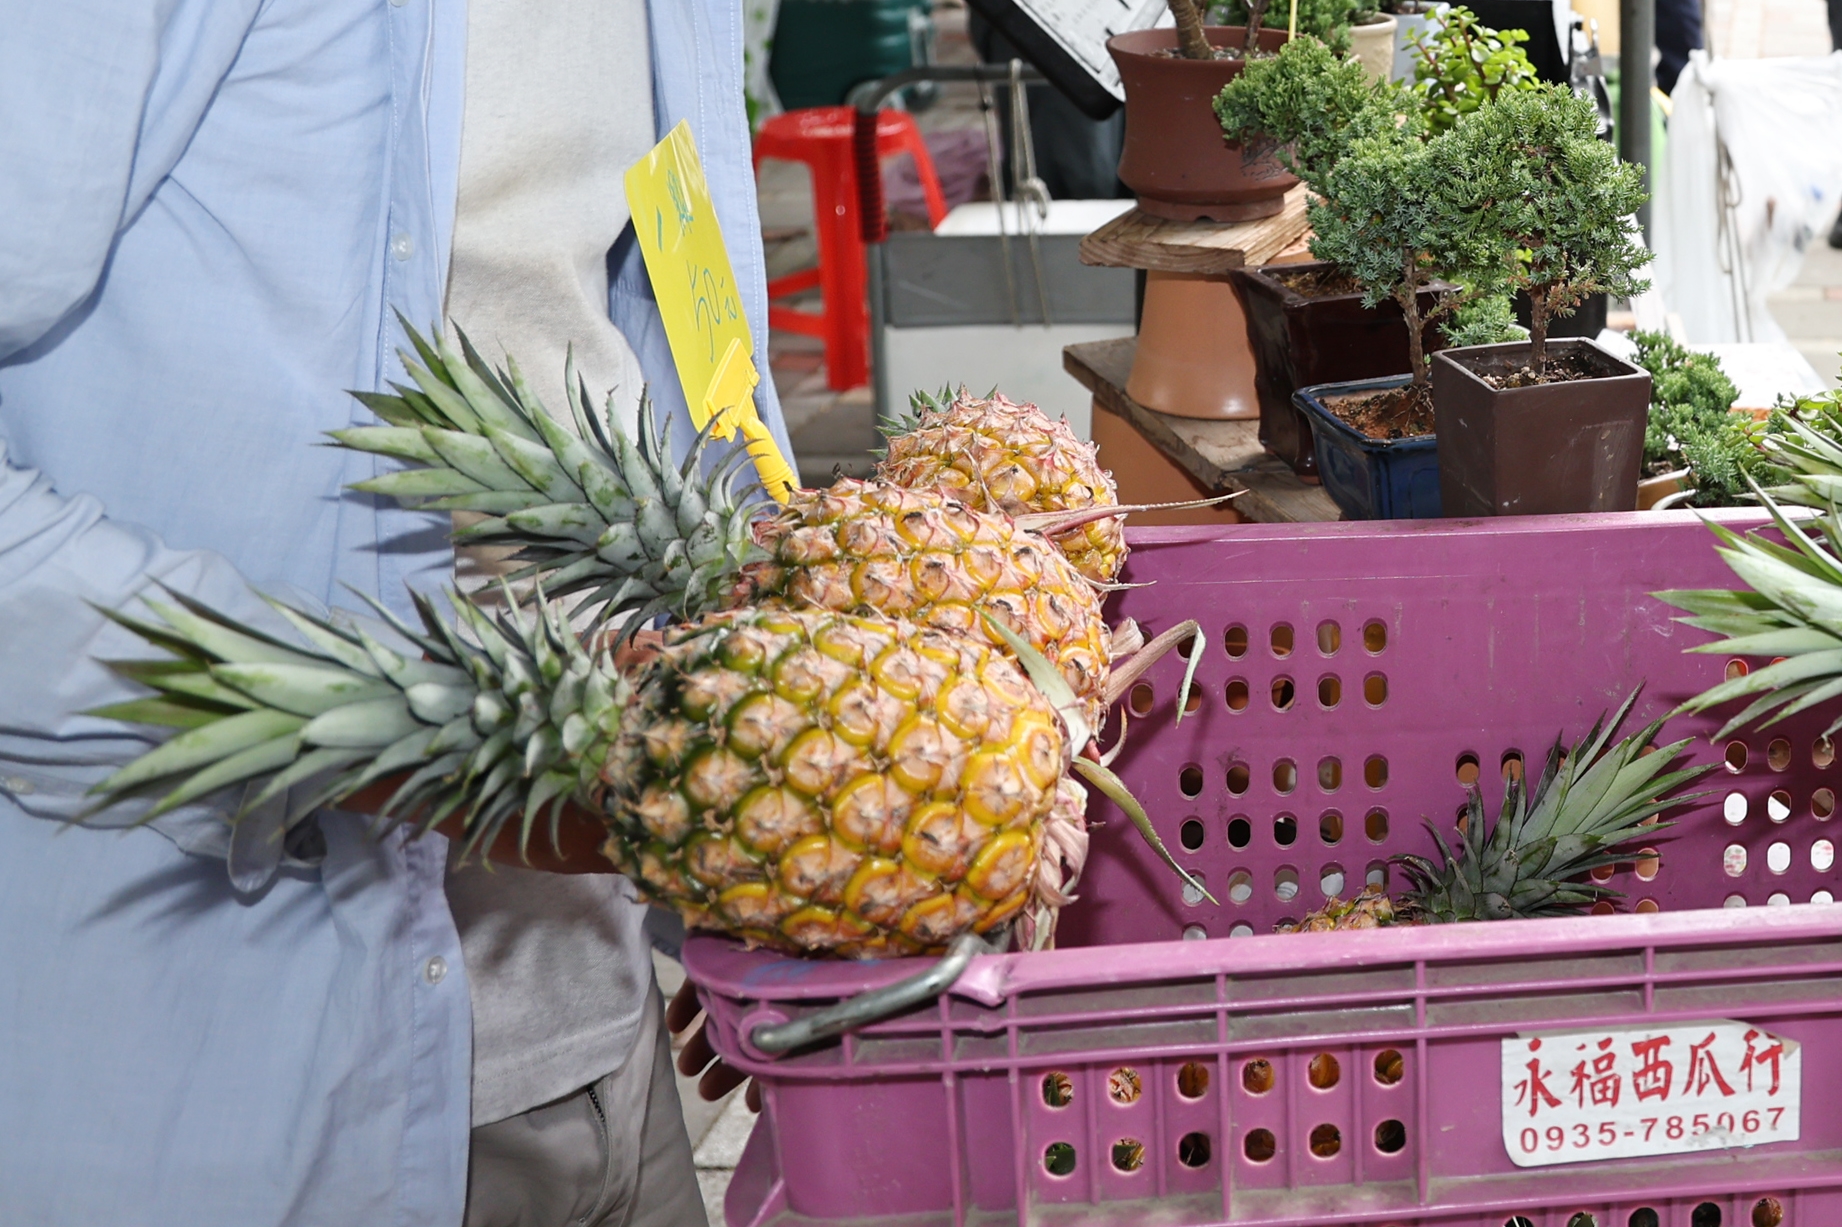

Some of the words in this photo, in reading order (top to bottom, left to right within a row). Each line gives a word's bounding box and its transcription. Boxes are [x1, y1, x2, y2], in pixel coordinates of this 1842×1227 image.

[1513, 1028, 1784, 1118] 永福西瓜行
[1519, 1106, 1786, 1154] 0935-785067
